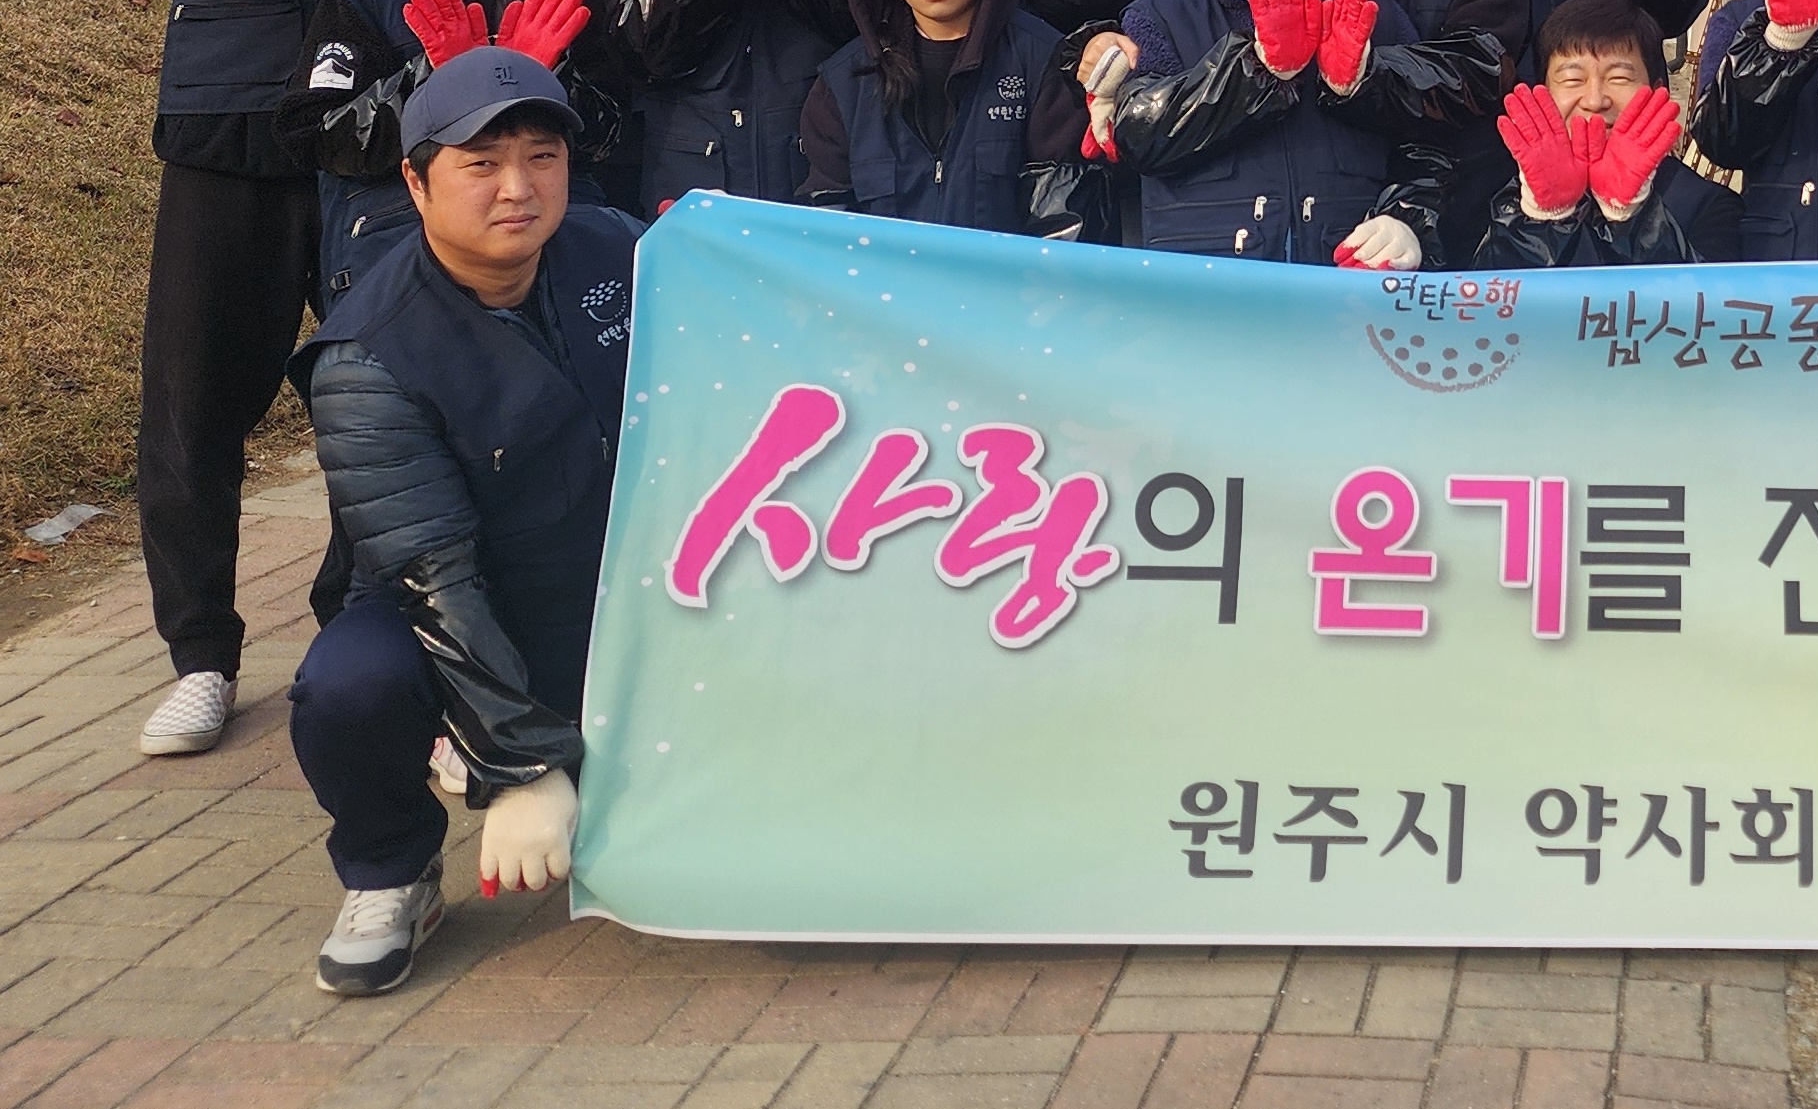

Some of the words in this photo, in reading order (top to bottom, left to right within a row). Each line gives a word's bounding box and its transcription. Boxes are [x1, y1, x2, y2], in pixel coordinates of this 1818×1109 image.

[987, 105, 1026, 120] 연탄은
[1382, 274, 1521, 320] 연탄은행
[597, 317, 631, 347] 연탄은
[664, 382, 1245, 649] 사랑의
[1307, 465, 1692, 640] 온기를
[1168, 778, 1466, 885] 원주시
